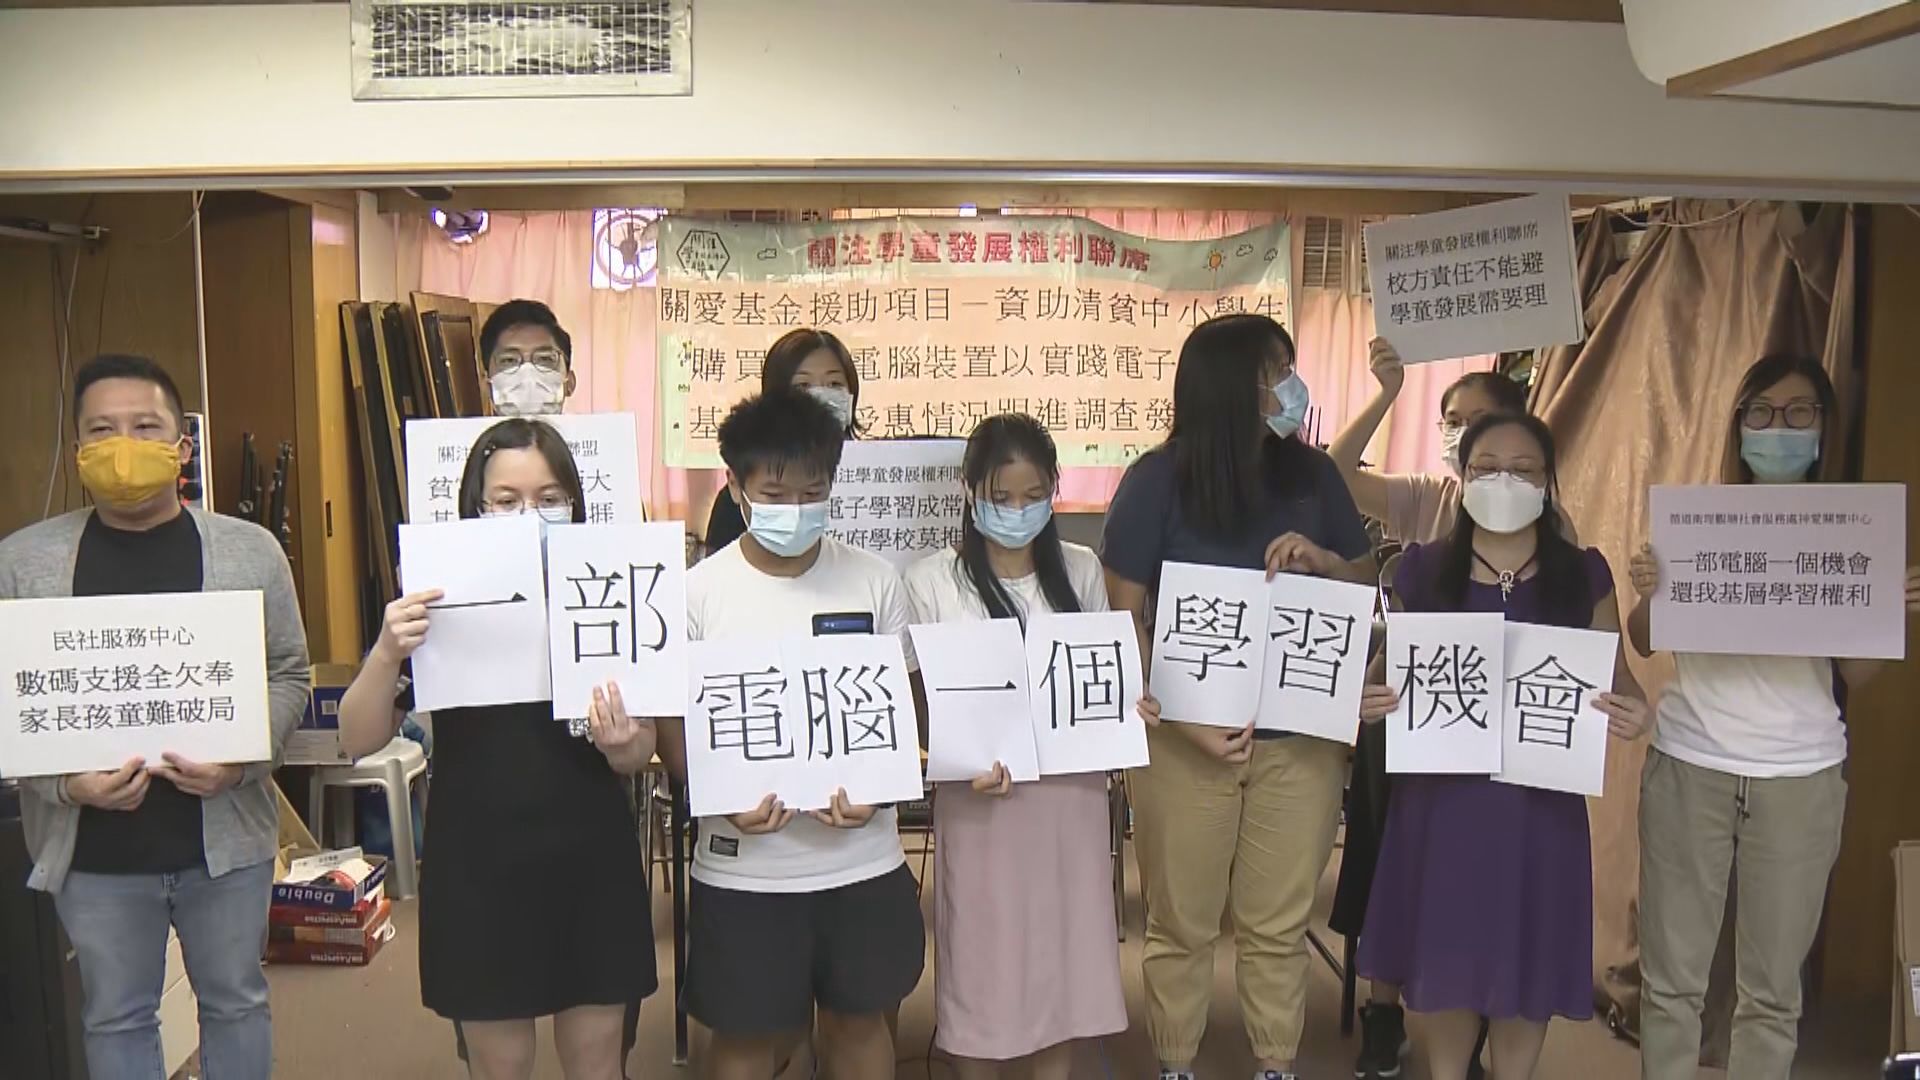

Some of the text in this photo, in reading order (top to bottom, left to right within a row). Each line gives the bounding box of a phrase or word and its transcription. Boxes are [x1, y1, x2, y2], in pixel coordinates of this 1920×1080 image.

[807, 230, 1151, 273] 關注學童發展權利聯席
[1387, 252, 1545, 296] 校方責任不能避
[1390, 282, 1549, 326] 學童發展需要理
[1669, 550, 1873, 577] 一部電腦一個機會
[1669, 580, 1873, 608] 還我基層學習權利
[52, 626, 195, 652] 民社服務中心
[15, 660, 235, 697] 數碼支援全欠奉
[18, 696, 236, 734] 家長孩童難破局
